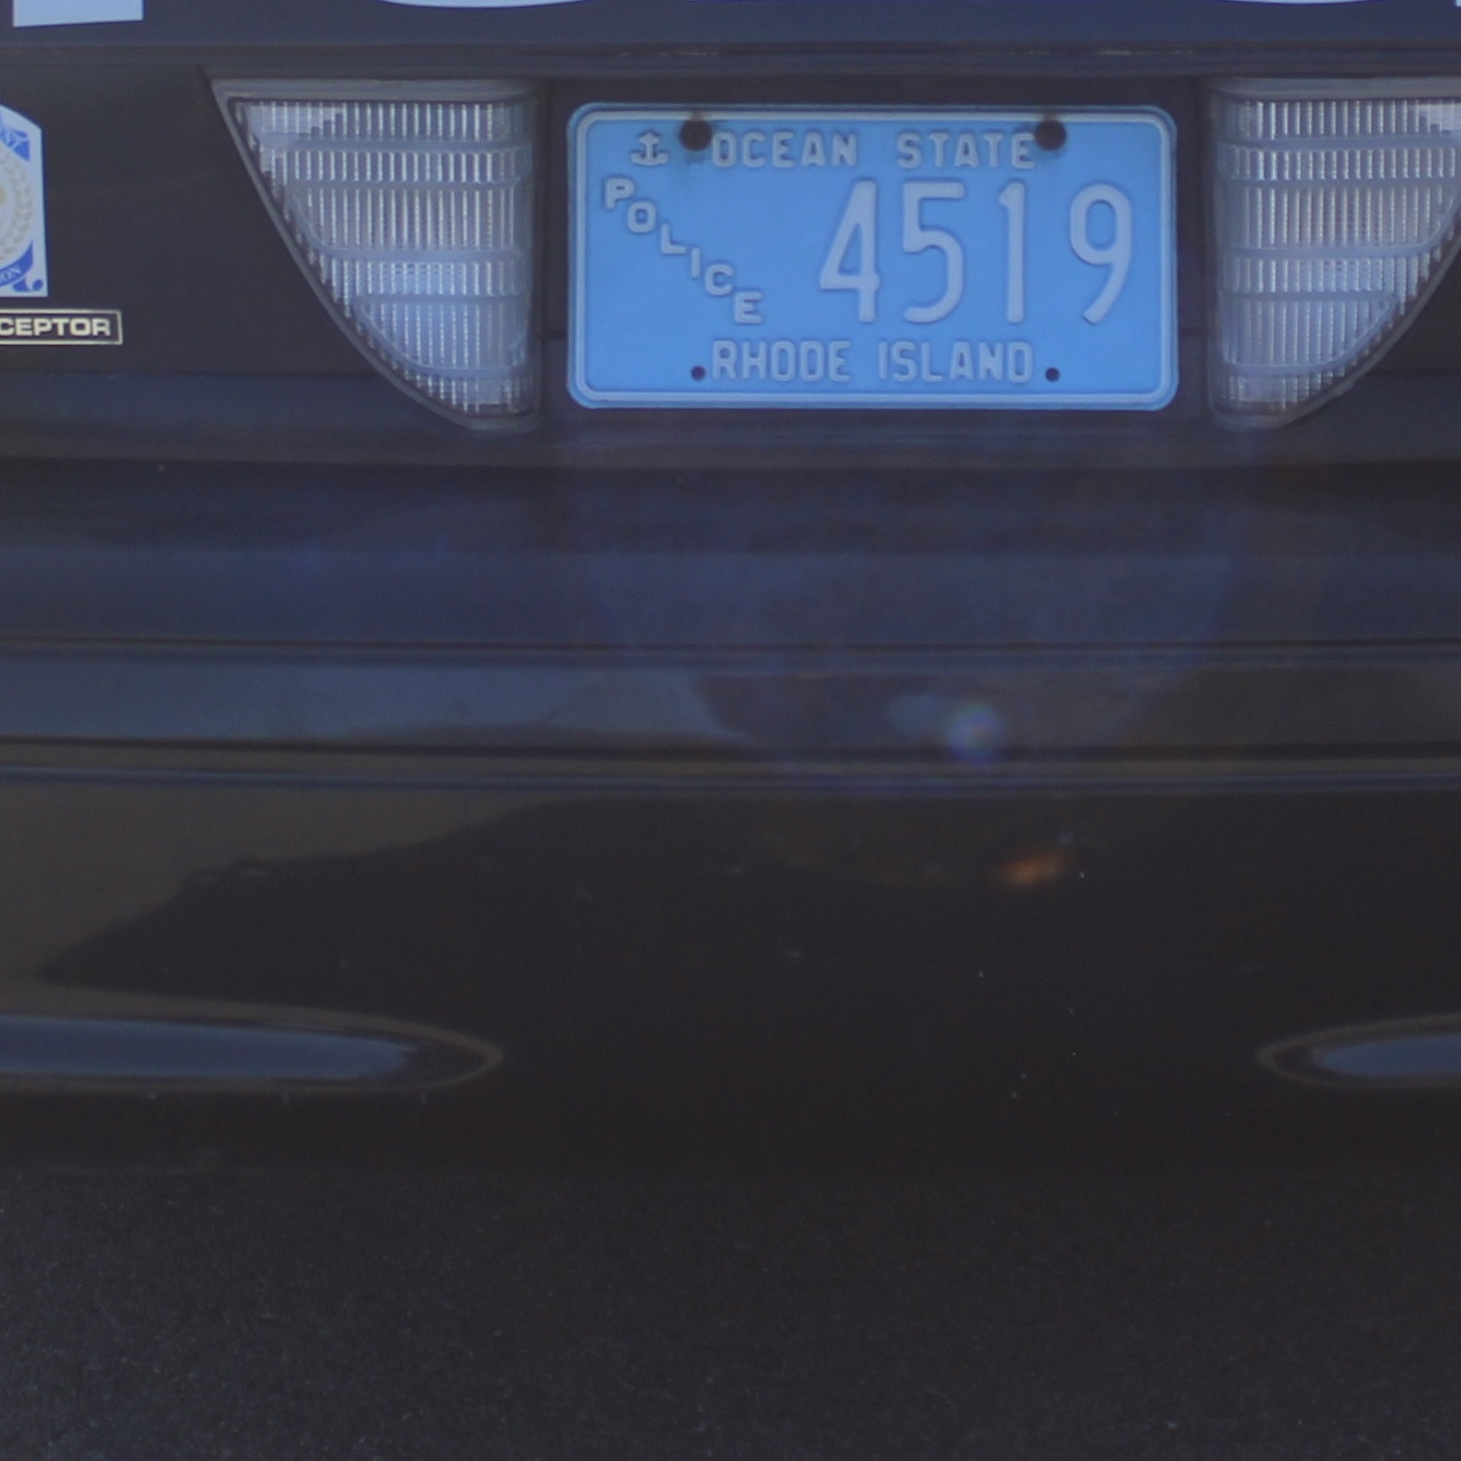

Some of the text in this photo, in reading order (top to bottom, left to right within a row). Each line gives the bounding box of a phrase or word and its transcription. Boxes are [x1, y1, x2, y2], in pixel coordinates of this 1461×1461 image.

[710, 131, 1036, 170] OCEAN STATE
[601, 175, 764, 326] POLICE
[818, 177, 1134, 326] 4519
[710, 339, 1035, 384] RHODE ISLAND
